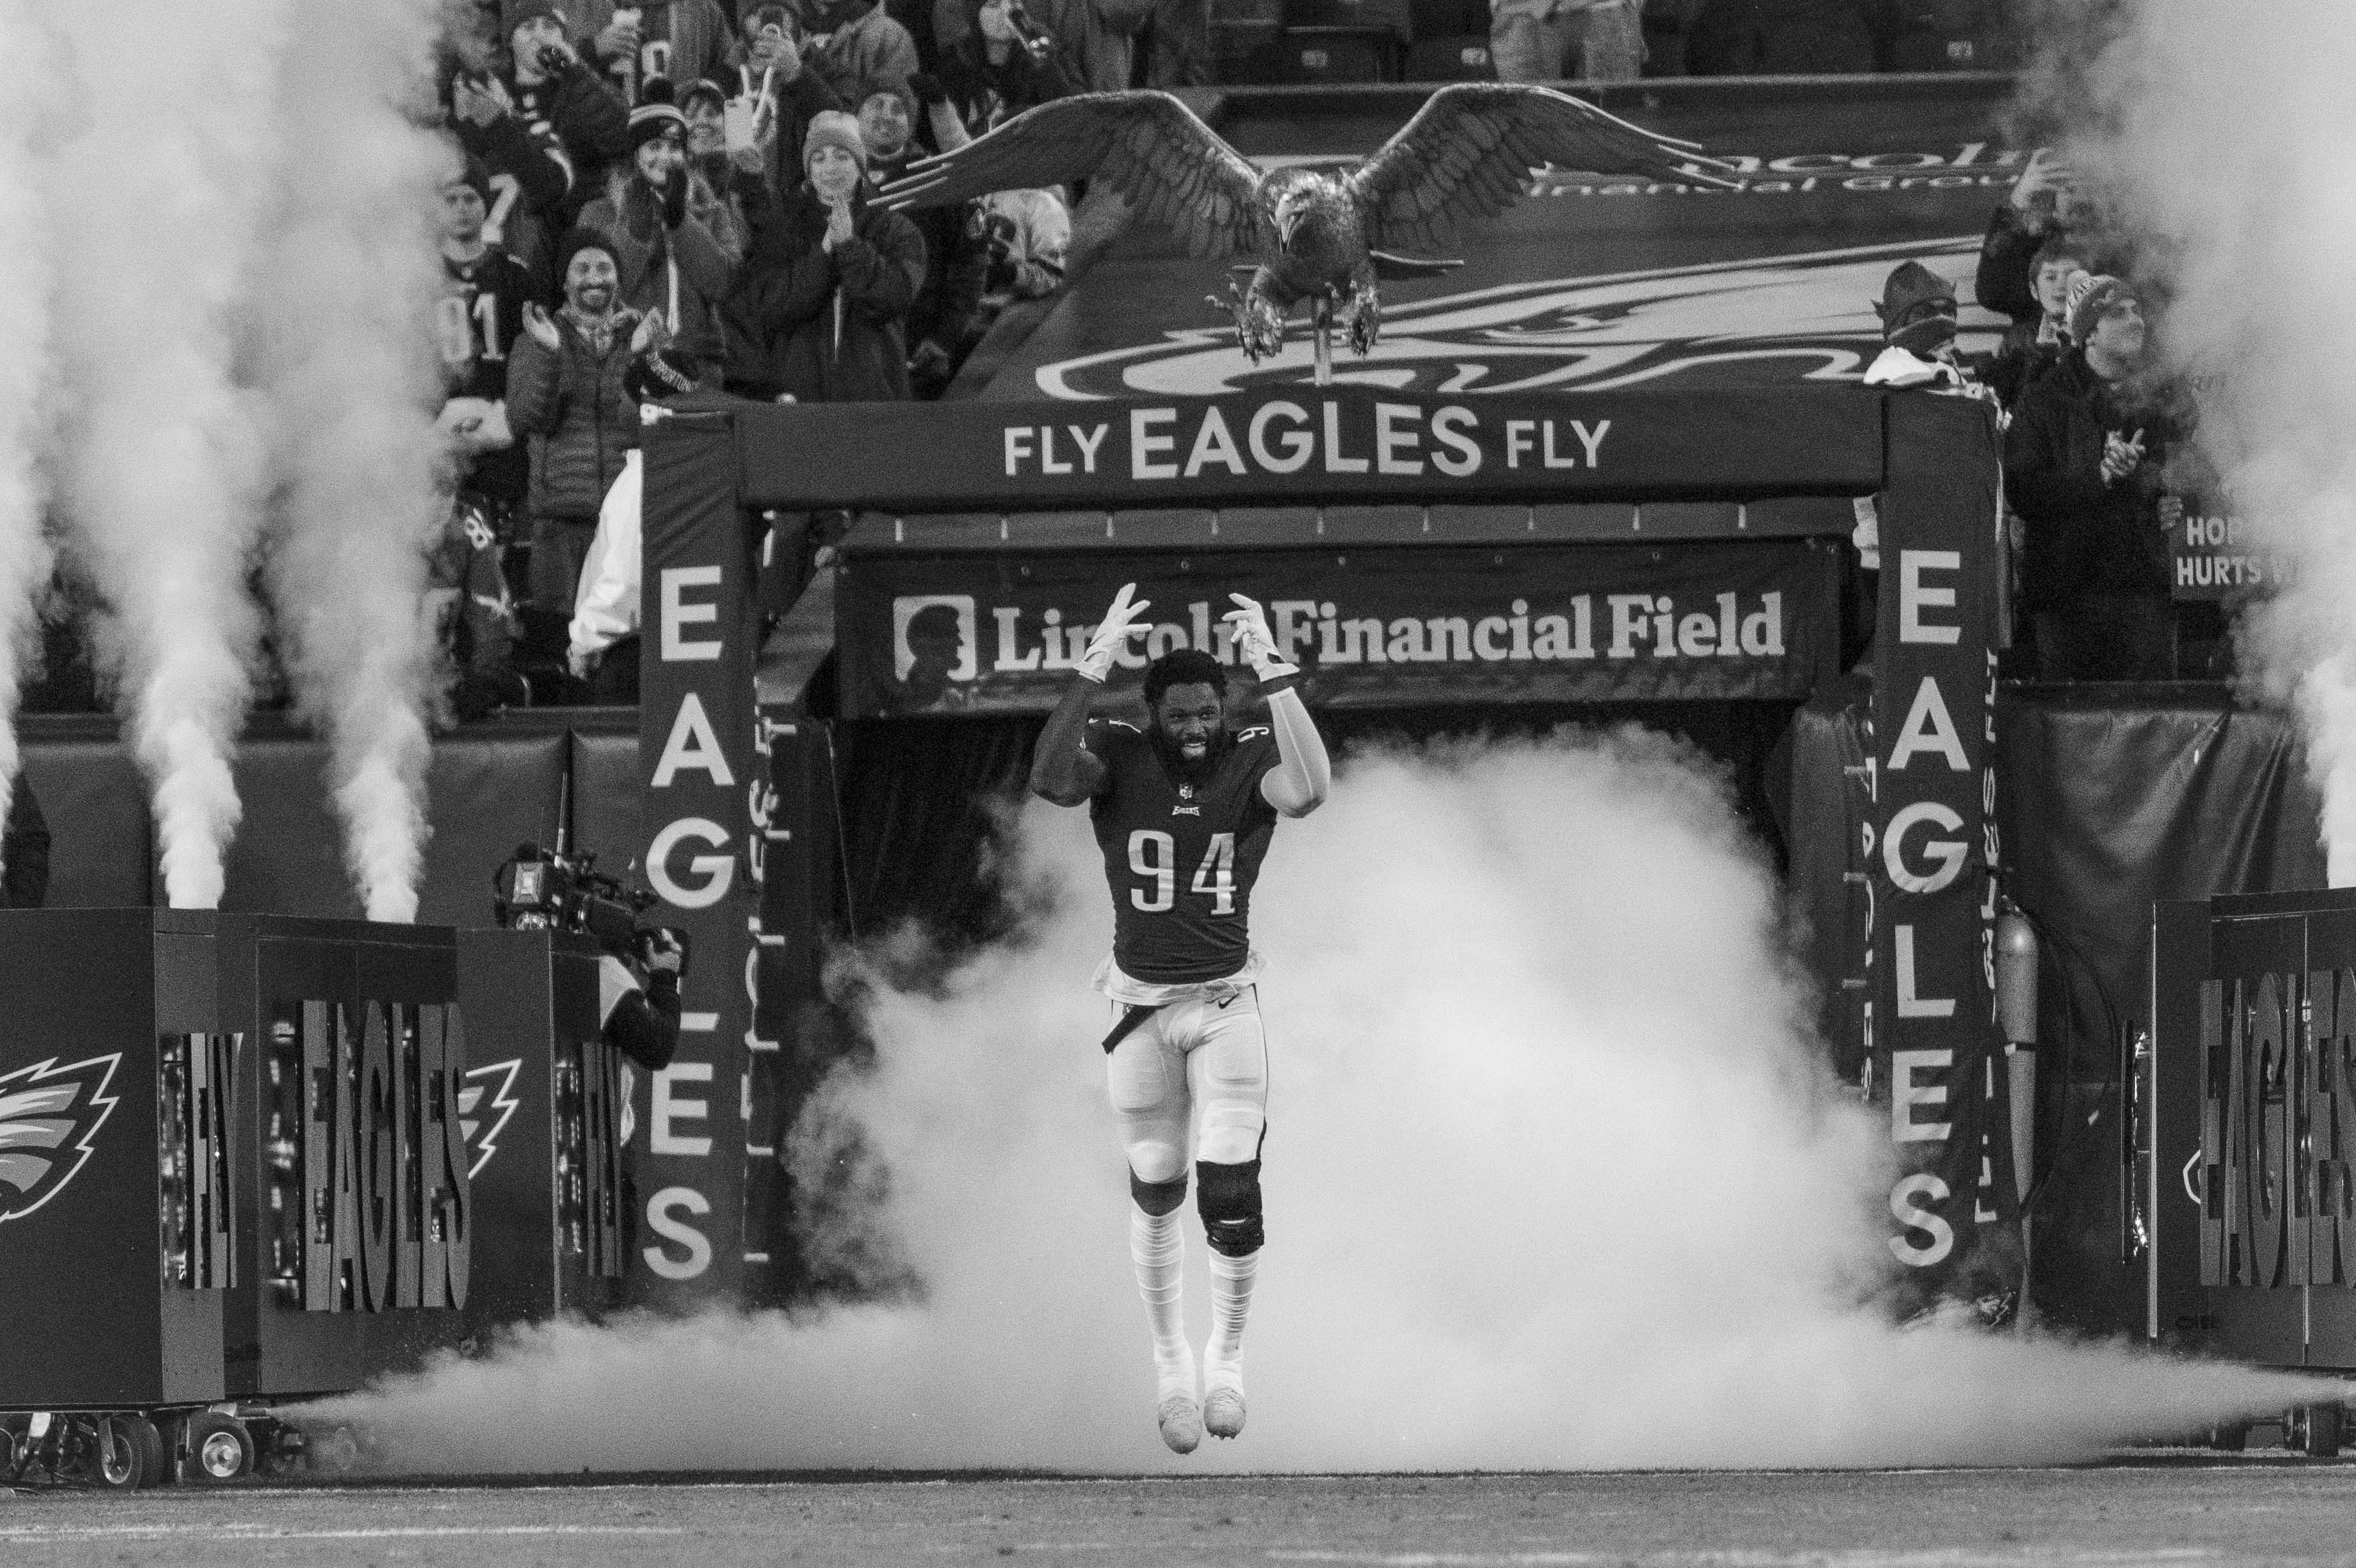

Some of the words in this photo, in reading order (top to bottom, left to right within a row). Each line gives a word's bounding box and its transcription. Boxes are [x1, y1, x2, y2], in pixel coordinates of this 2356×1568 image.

[1003, 423, 1108, 476] FLY
[1130, 401, 1483, 479] EAGLES
[1505, 420, 1611, 469] FLY
[2176, 556, 2263, 586] HURTS
[1270, 593, 1595, 666] Financial
[1606, 591, 1785, 658] Field
[1128, 830, 1236, 915] 94
[1882, 549, 1972, 1267] EAGLES
[303, 999, 470, 1313] EAGLES
